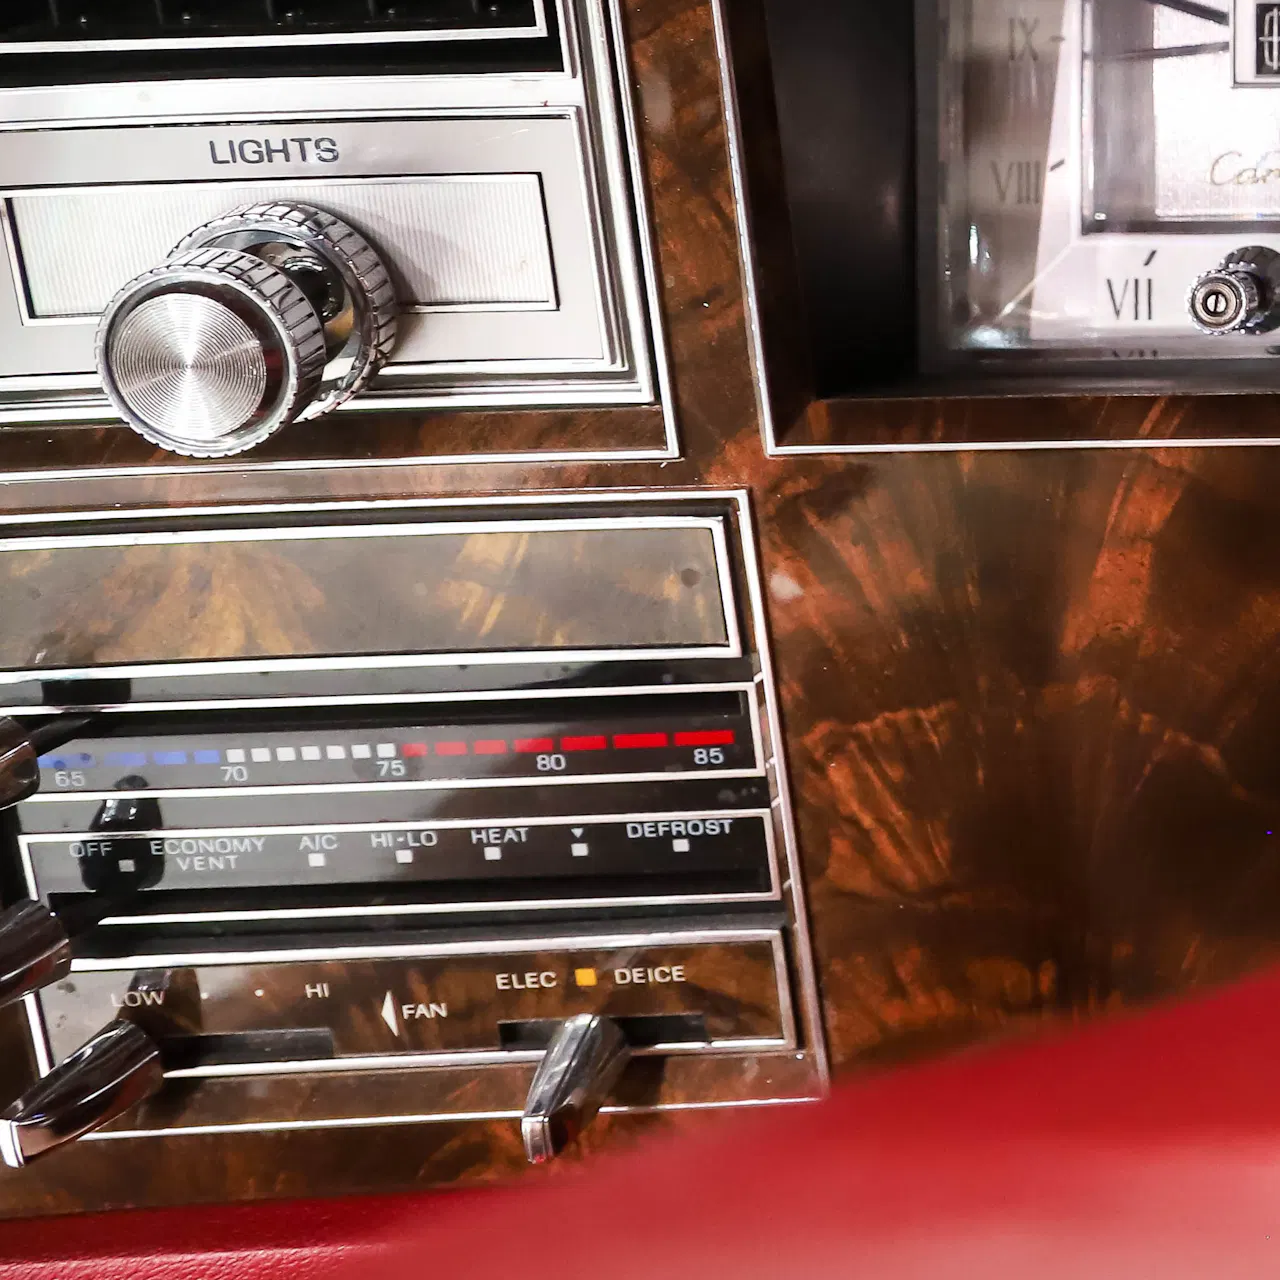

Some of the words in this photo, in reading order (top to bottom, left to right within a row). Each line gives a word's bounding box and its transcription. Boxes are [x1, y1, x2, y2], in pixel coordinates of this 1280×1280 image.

[1007, 18, 1039, 61] IX
[210, 136, 340, 167] LIGHTS
[990, 160, 1041, 204] VIII
[1106, 277, 1153, 321] VII
[54, 770, 86, 788] 65
[220, 765, 249, 783] 70
[376, 759, 406, 777] 75
[535, 754, 567, 772] 80
[693, 747, 725, 765] 85
[68, 841, 114, 859] OFF
[150, 836, 267, 856] ECONOMY
[299, 834, 339, 851] A/C
[470, 827, 529, 845] HEAT
[625, 819, 734, 840] DEFROST
[175, 854, 240, 872] VENT
[495, 970, 558, 990] ELEC
[614, 964, 687, 985] DEICE
[110, 990, 166, 1009] LOW
[304, 982, 331, 999] HI
[401, 1001, 449, 1021] FAN
